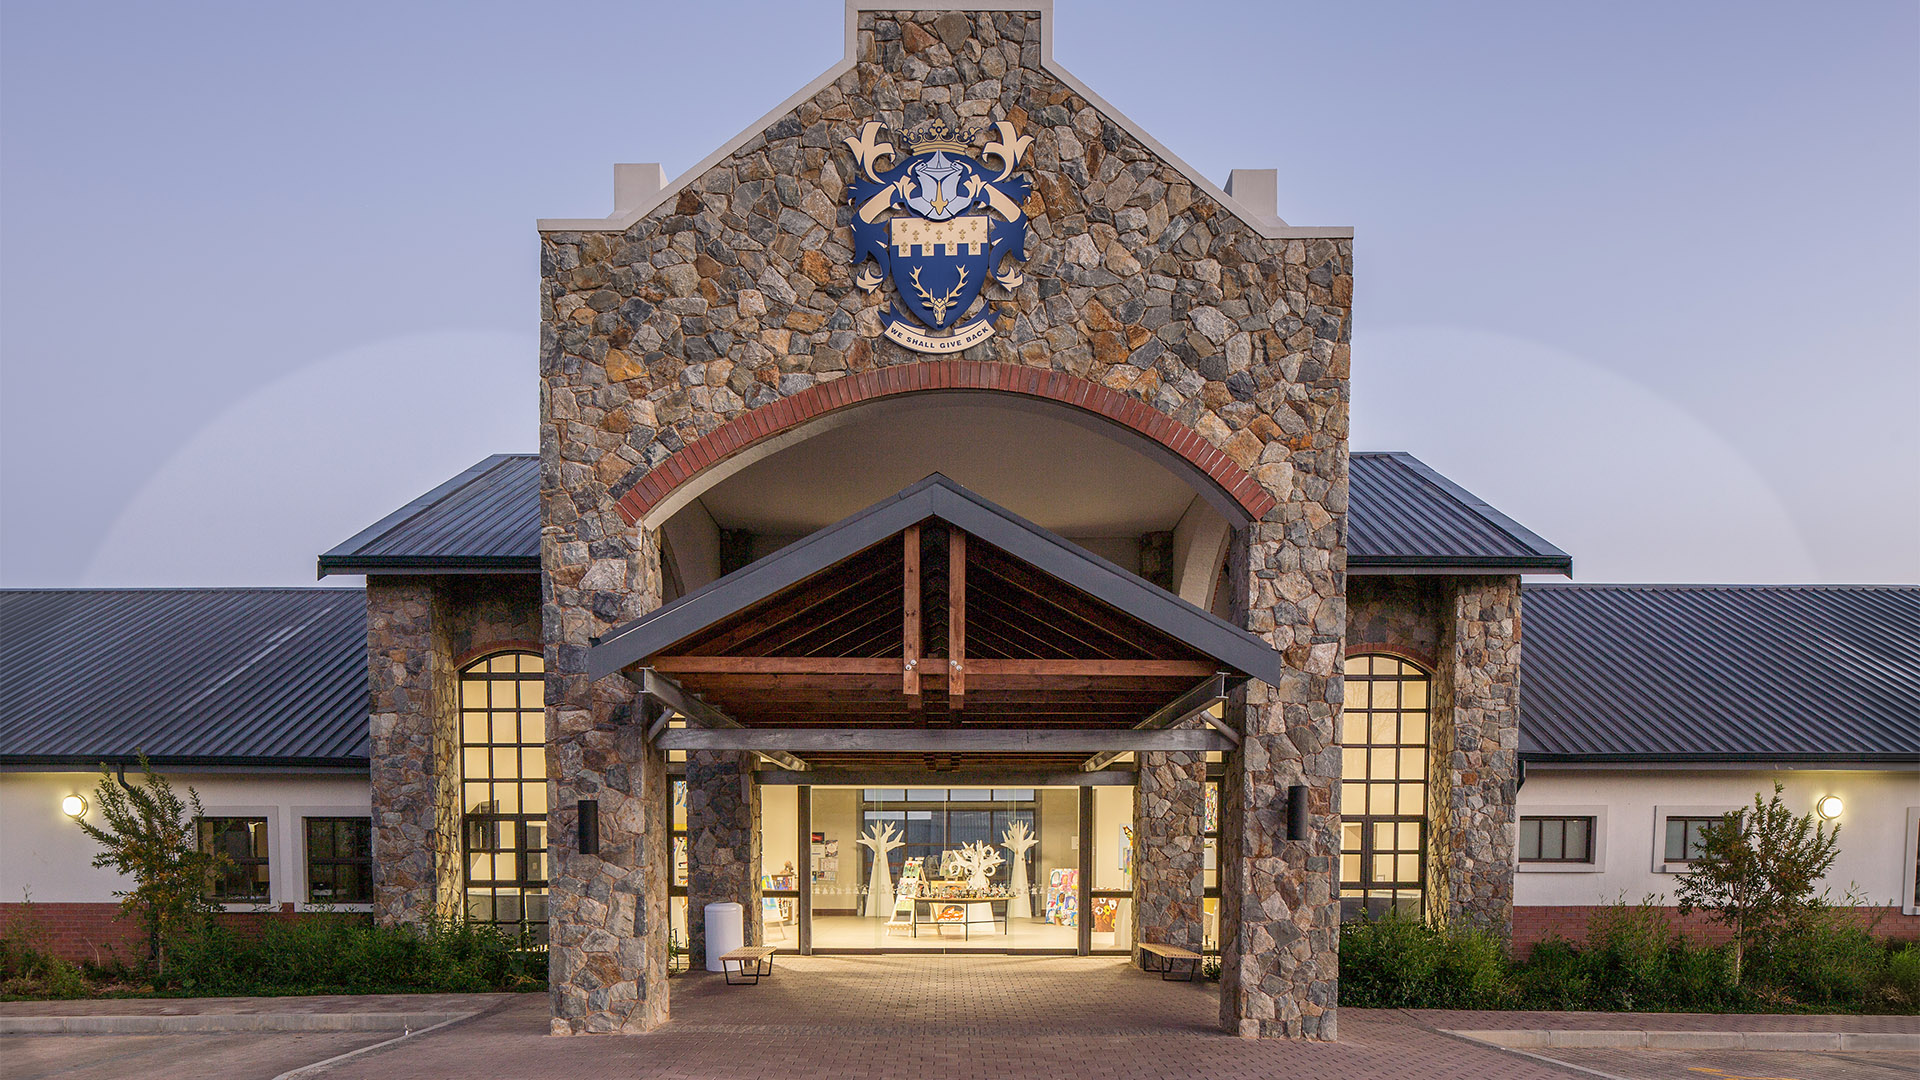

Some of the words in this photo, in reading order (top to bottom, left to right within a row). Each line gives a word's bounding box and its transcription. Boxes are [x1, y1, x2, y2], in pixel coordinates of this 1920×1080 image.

[890, 327, 903, 339] WE
[906, 336, 935, 349] SHALL
[939, 340, 962, 349] GIVE
[966, 326, 989, 343] BACK
